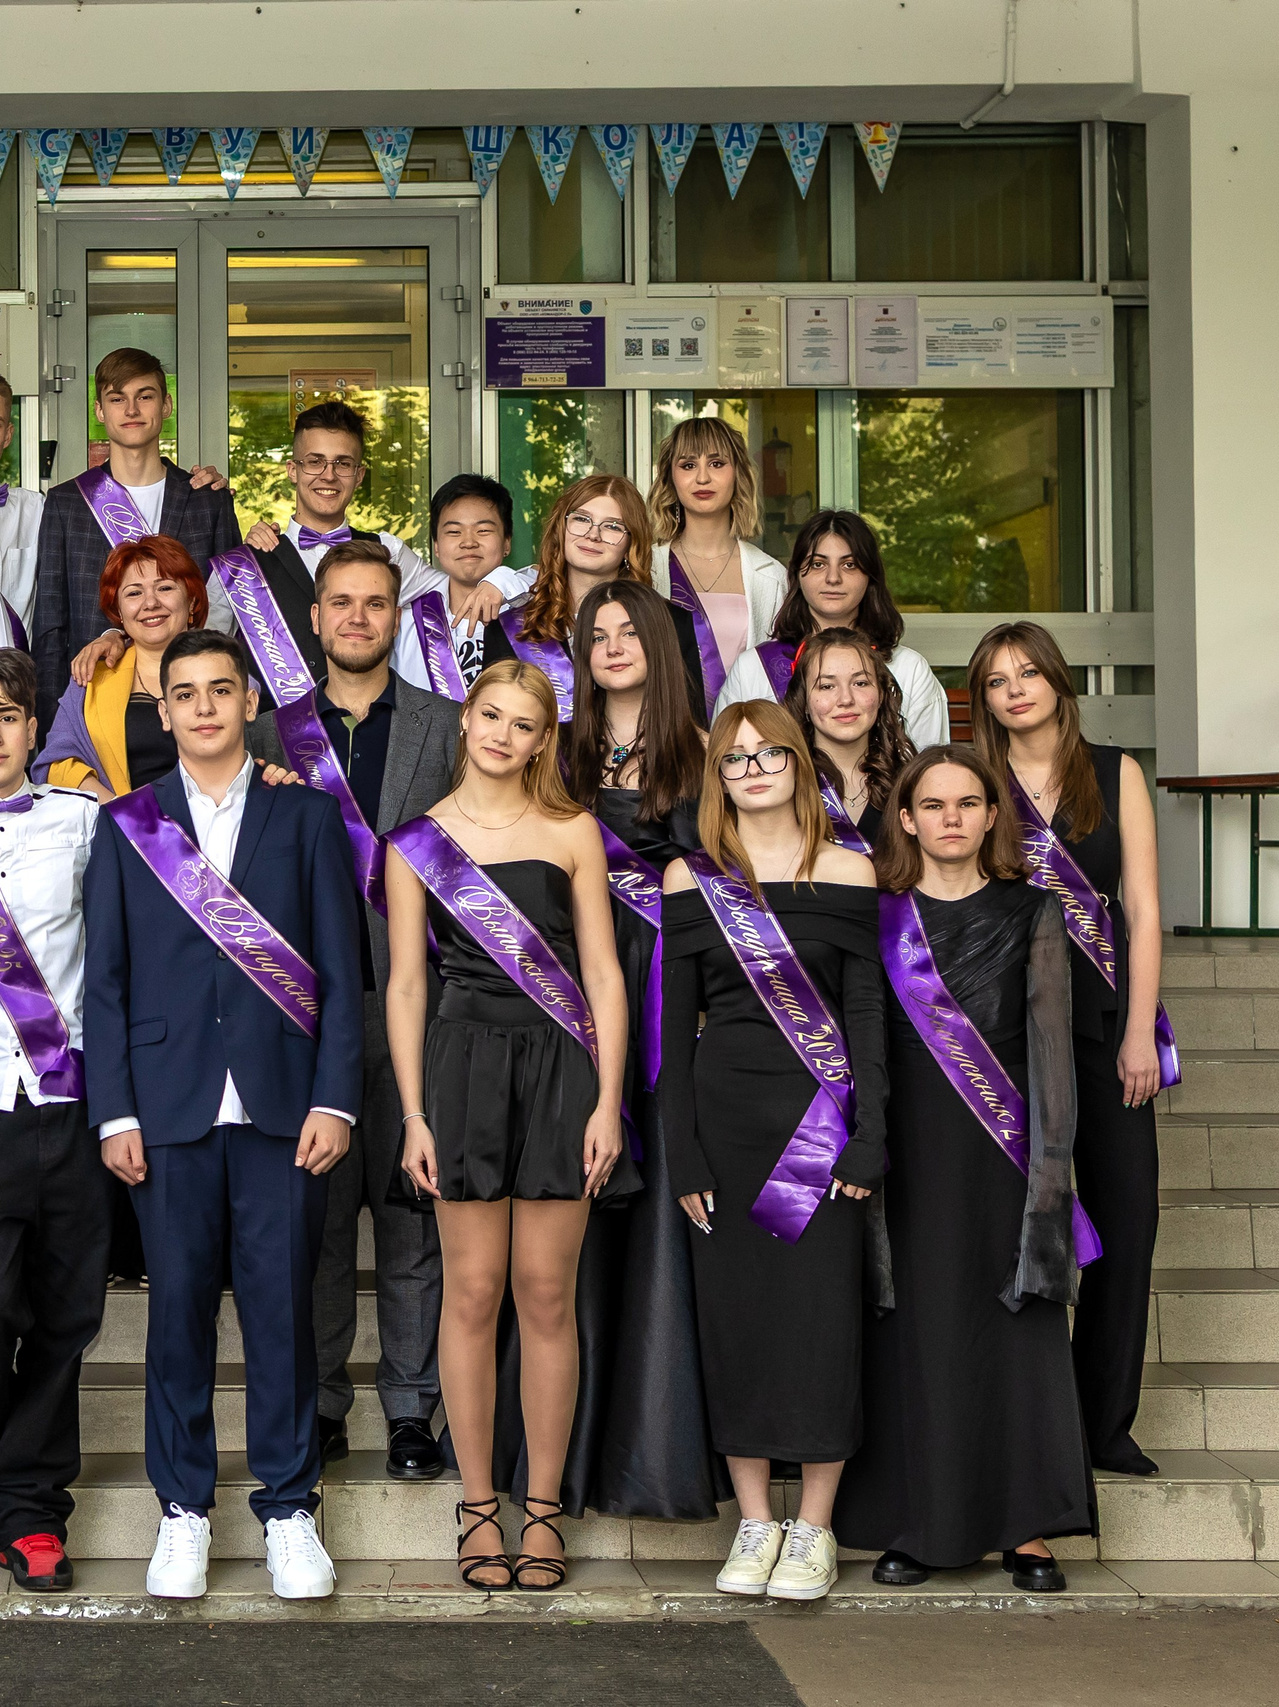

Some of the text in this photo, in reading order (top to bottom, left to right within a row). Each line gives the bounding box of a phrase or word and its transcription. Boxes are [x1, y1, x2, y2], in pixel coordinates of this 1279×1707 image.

[518, 299, 573, 308] ВНИМАНИЕ!
[218, 550, 291, 675] Выпускник
[452, 885, 579, 1014] Выпускница
[709, 875, 852, 1082] Выпускница 2025
[902, 975, 1016, 1124] Выпускник
